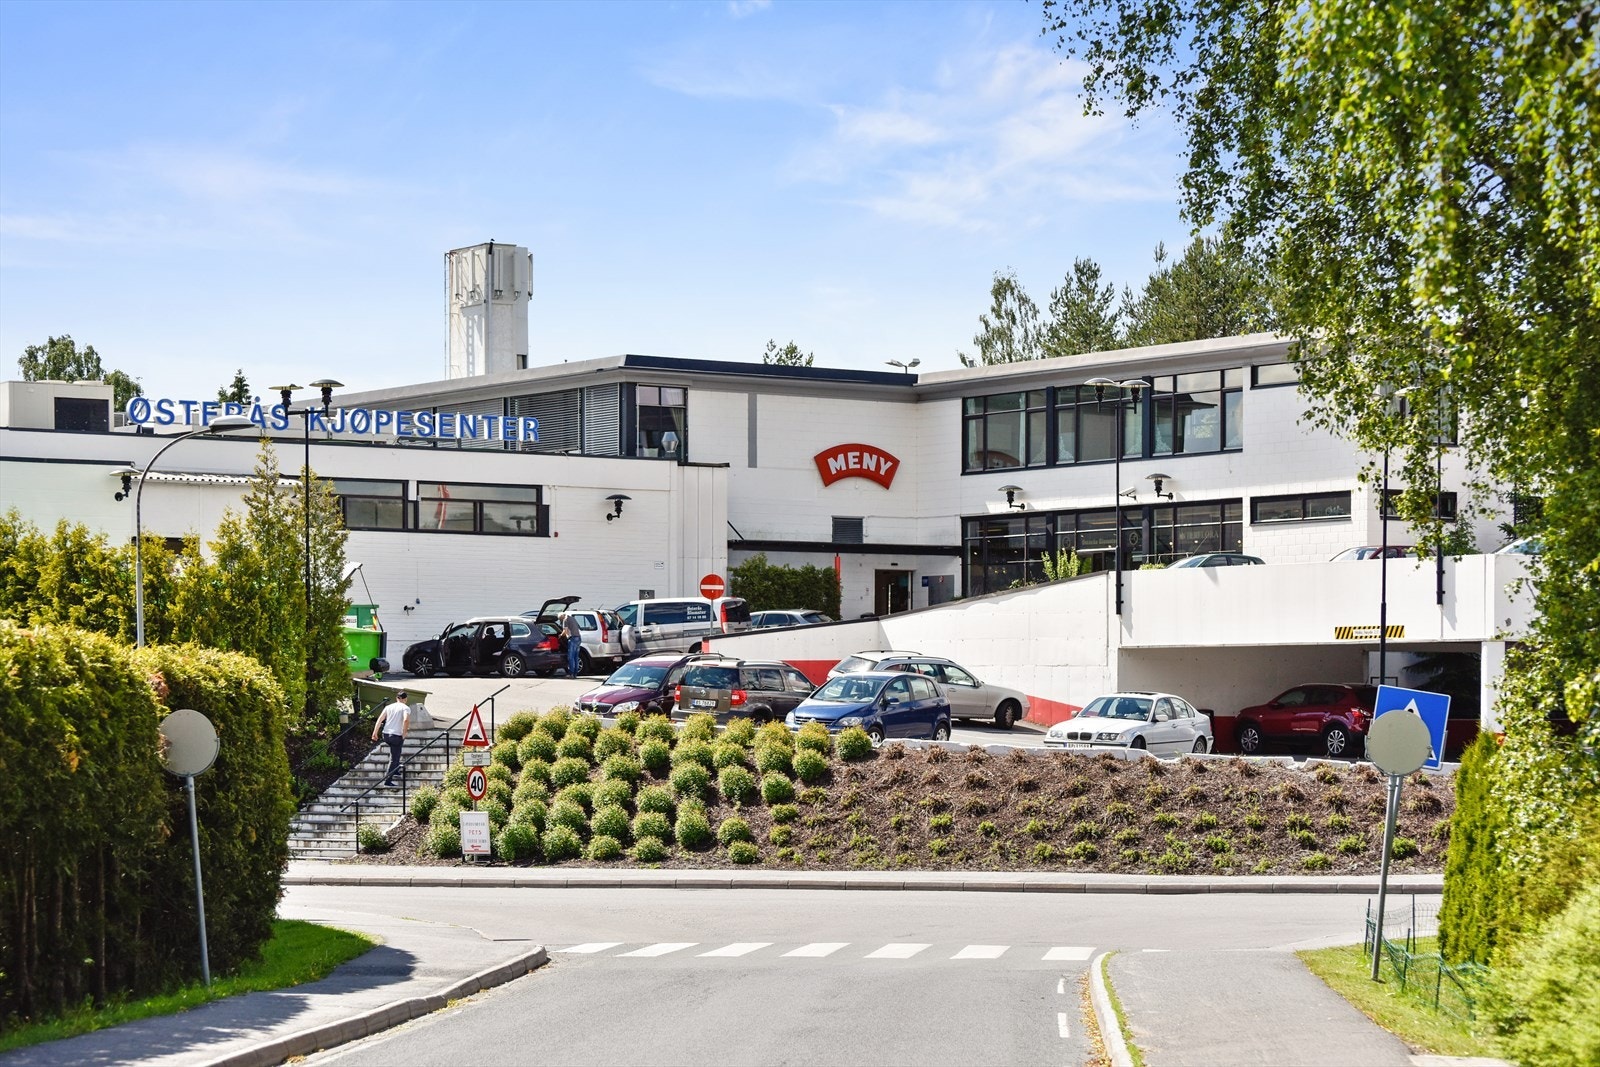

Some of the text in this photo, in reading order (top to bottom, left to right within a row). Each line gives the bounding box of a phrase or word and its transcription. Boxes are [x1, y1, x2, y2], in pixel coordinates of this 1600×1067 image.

[126, 396, 540, 442] ØSTERÅS KJØPESENTER
[827, 451, 893, 476] MENY
[471, 776, 484, 792] 40
